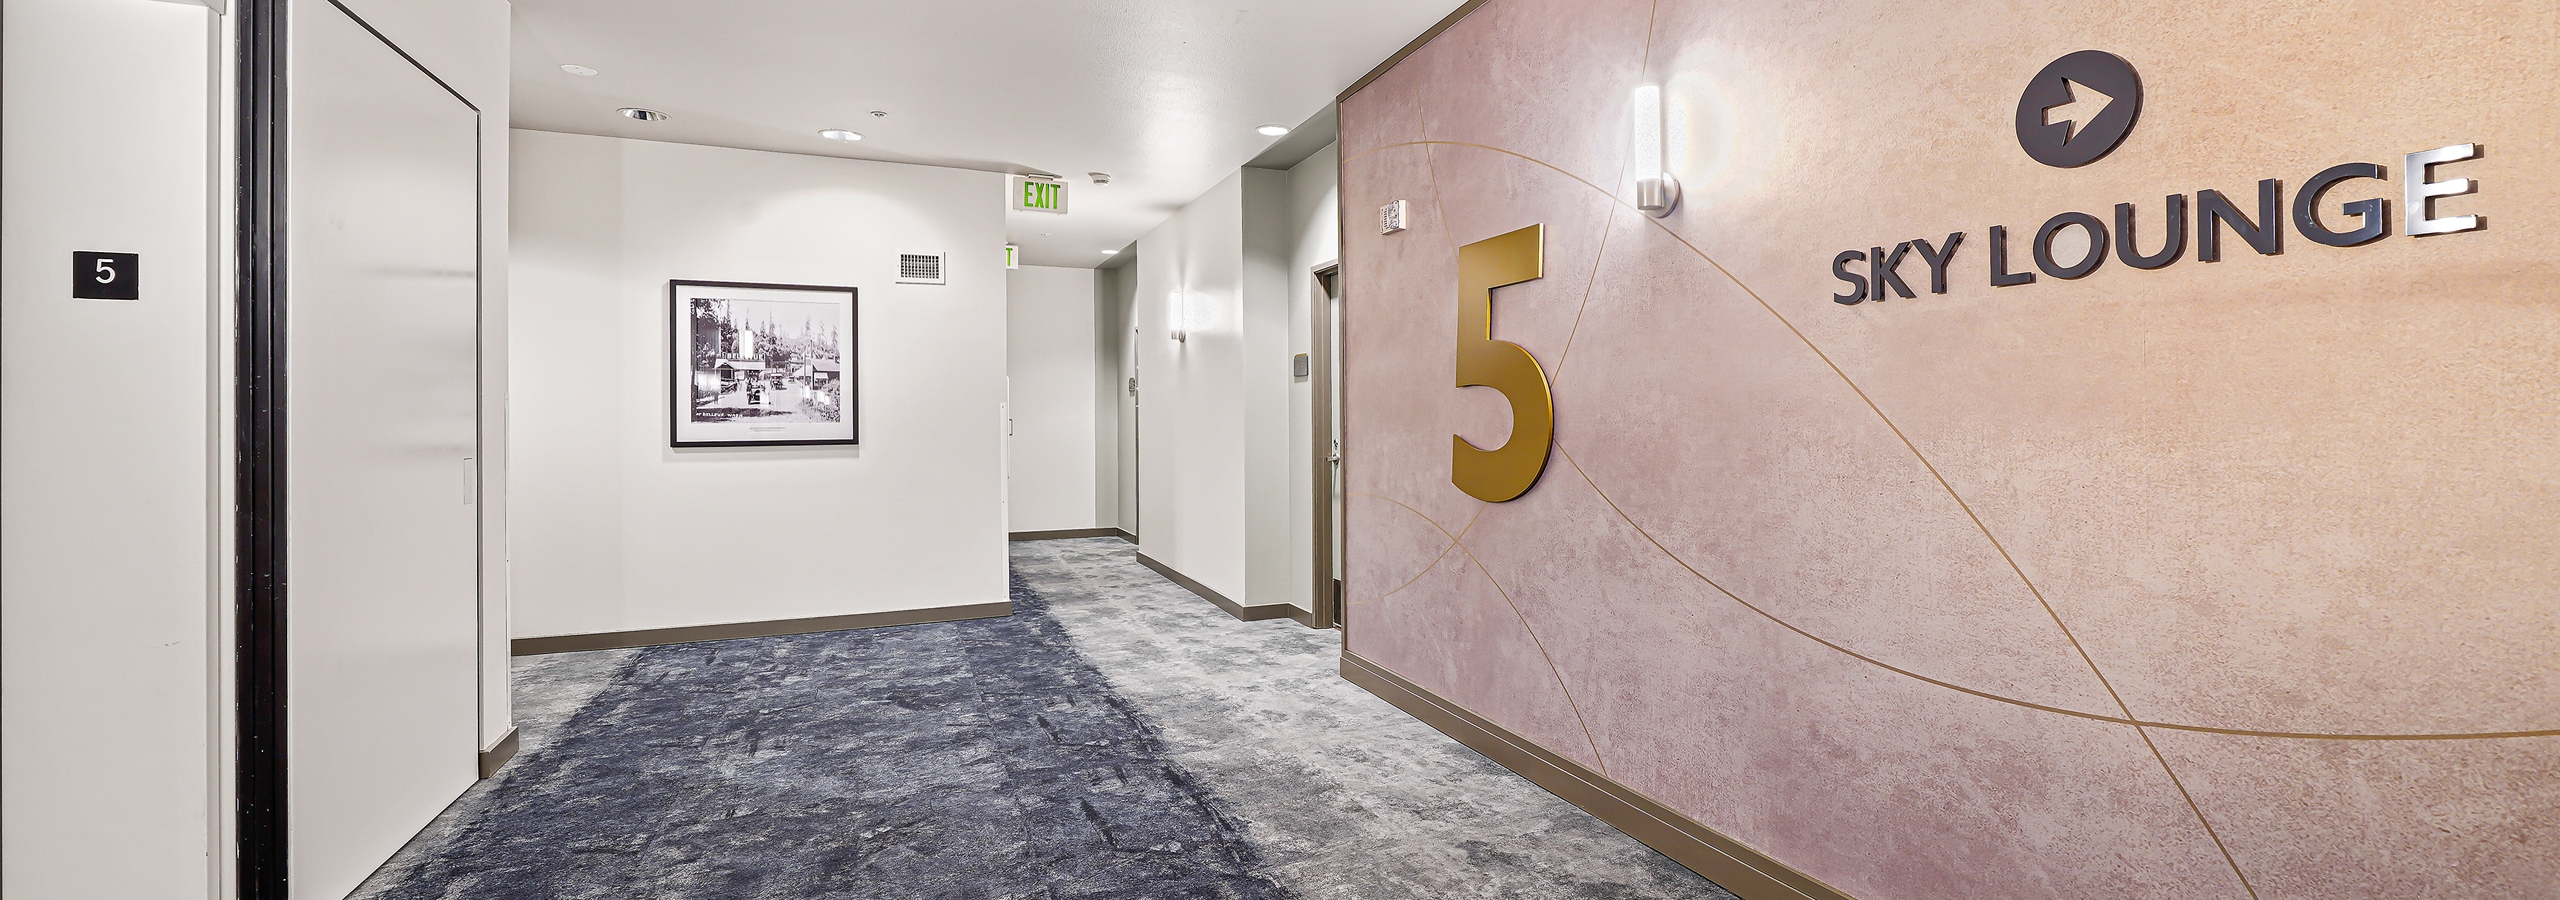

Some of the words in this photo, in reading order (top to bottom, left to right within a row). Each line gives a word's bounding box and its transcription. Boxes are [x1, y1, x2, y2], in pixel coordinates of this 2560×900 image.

[1024, 181, 1061, 210] EXIT
[1832, 232, 1966, 306] SKY
[1989, 143, 2480, 287] LOUNGE
[96, 259, 116, 284] 5
[1452, 223, 1554, 503] 5
